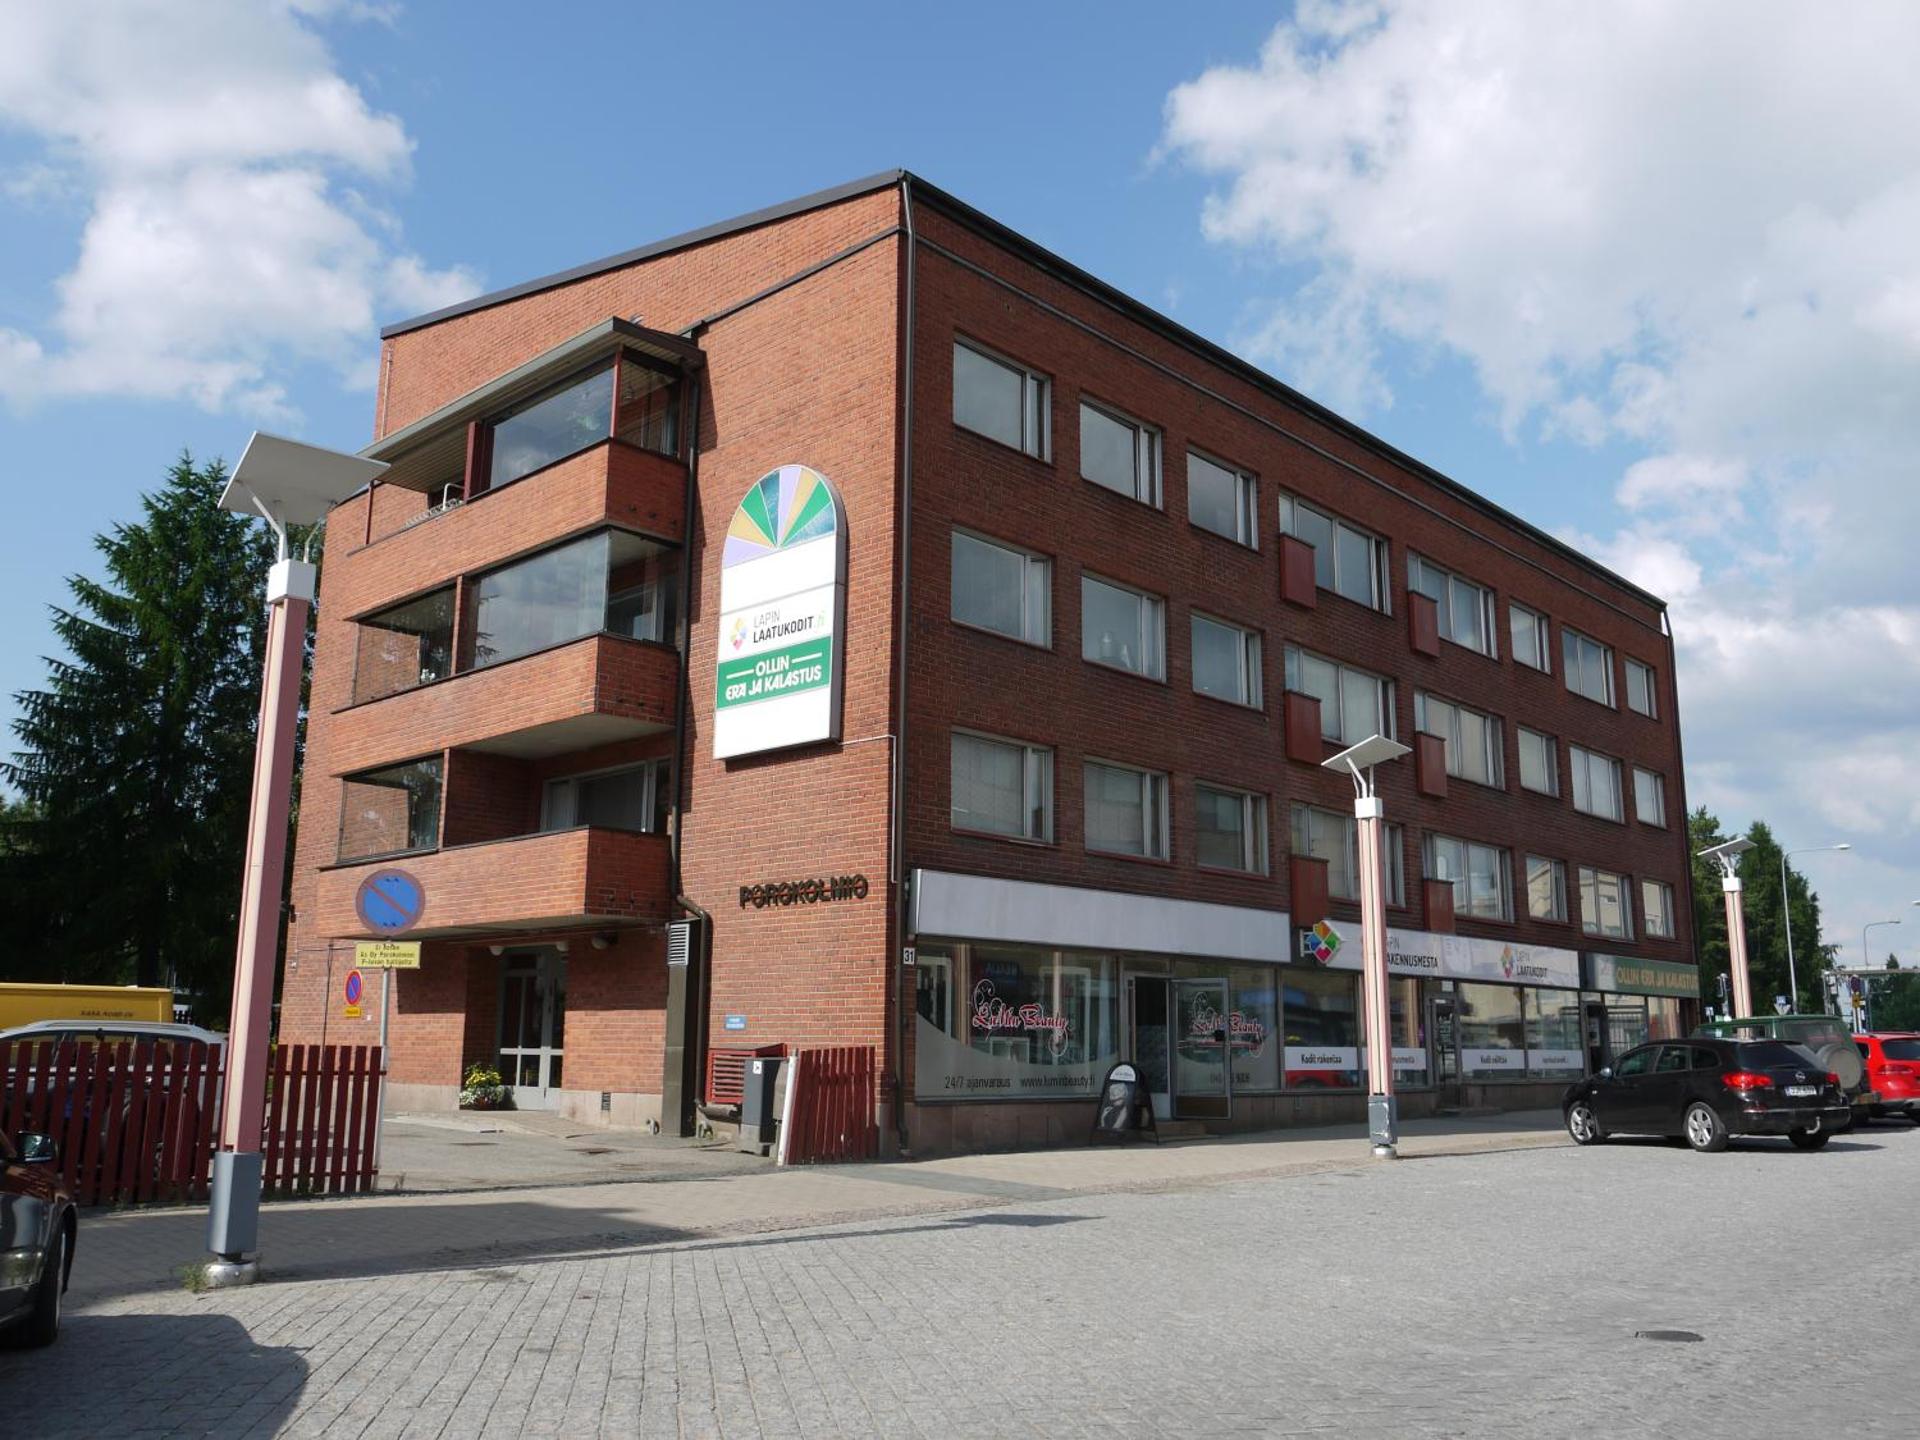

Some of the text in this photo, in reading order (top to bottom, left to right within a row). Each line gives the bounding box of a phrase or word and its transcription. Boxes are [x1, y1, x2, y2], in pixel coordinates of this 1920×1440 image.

[753, 608, 780, 628] LAPIN
[755, 655, 789, 676] OLLIN
[748, 677, 762, 696] JA
[764, 665, 822, 692] KALASTUS
[739, 873, 869, 910] POROKOLMIO
[904, 950, 914, 962] 31
[945, 1075, 964, 1089] 24/7
